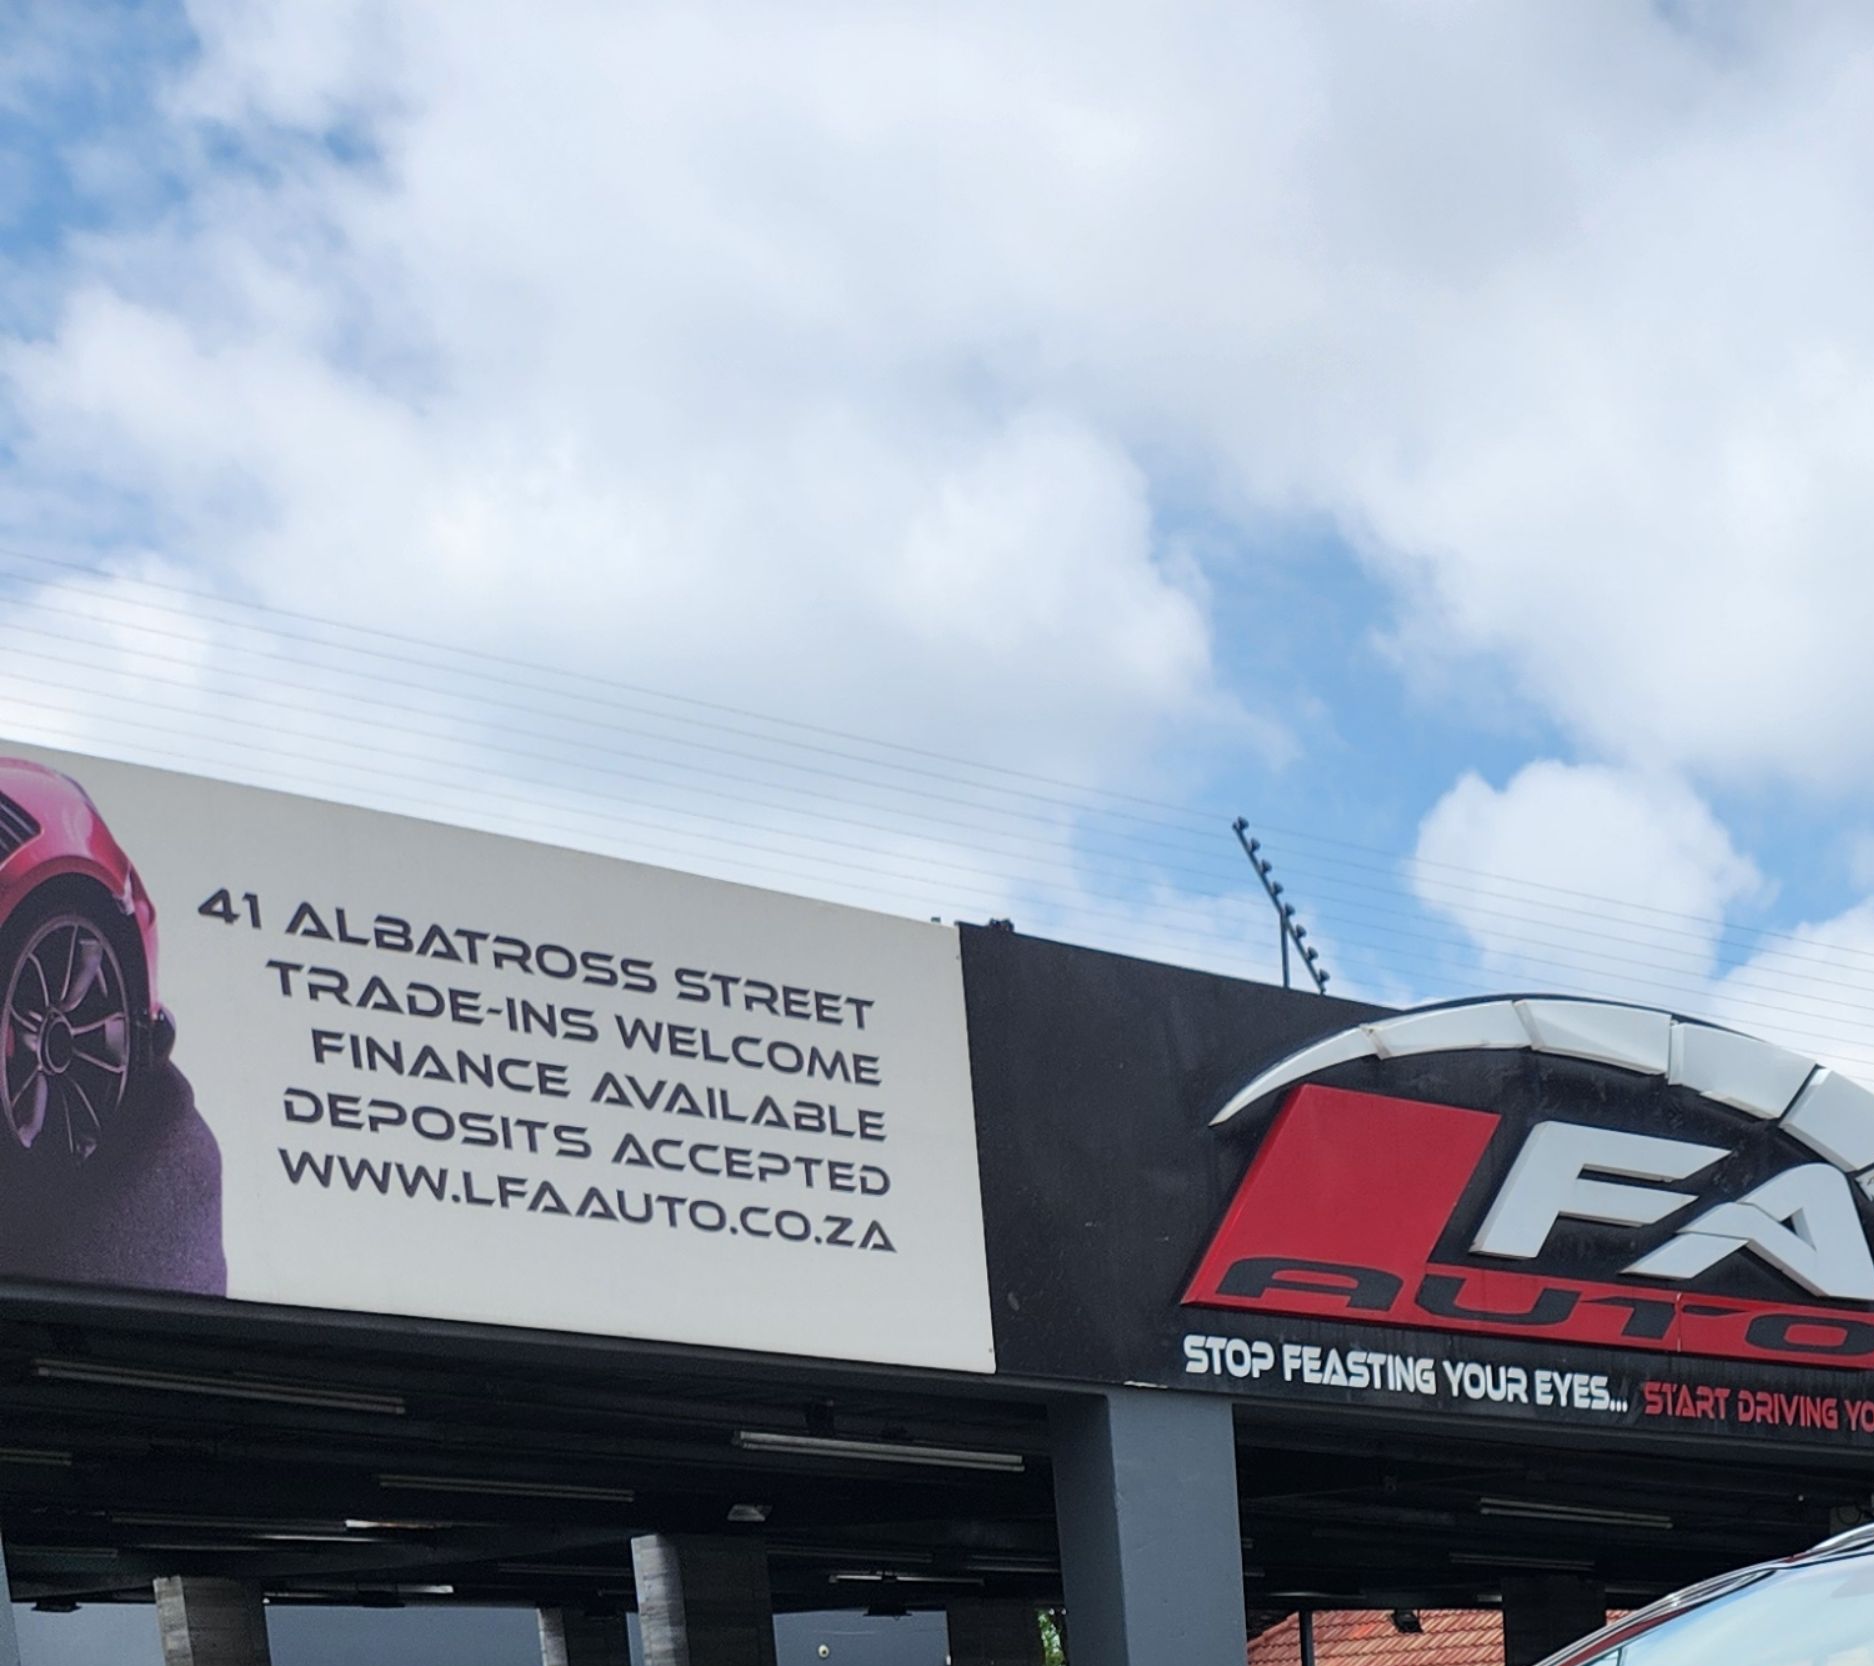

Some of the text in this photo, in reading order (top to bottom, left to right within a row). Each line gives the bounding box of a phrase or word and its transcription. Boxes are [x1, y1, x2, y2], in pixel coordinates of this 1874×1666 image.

[197, 888, 875, 1030] 41 ALBATROSS STREET
[265, 959, 882, 1087] TRADE-INS WELCOME
[311, 1028, 887, 1142] FINANCE AVAILABLE
[283, 1087, 891, 1196] DEPOSITS ACCEPTED
[278, 1148, 896, 1252] WWW.LFAAUTO.CO.ZA
[1183, 1335, 1275, 1378] STOP
[1282, 1344, 1437, 1395] FEASTING
[1442, 1360, 1528, 1404] YOUR
[1534, 1370, 1628, 1413] EYES...
[1643, 1382, 1730, 1420] START
[1738, 1391, 1838, 1430] DRIVING
